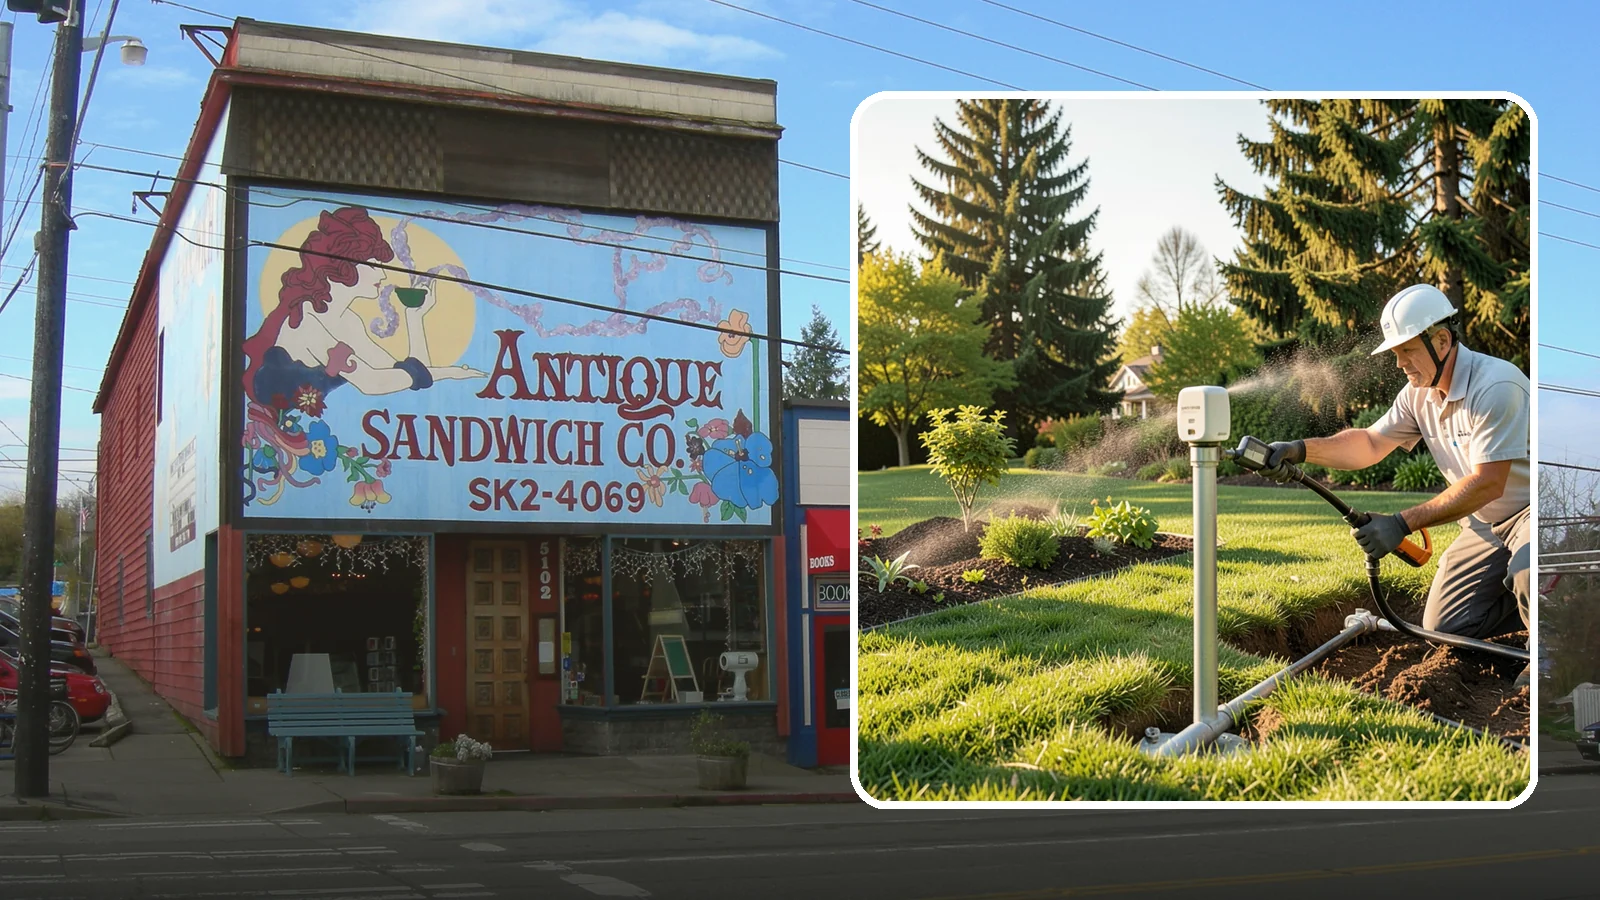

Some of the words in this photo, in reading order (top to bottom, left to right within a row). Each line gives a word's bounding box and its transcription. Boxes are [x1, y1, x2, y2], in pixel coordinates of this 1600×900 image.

[476, 329, 724, 420] ANTIQUE
[361, 408, 604, 467] SANDWICH
[617, 420, 685, 469] CO.
[468, 478, 646, 513] SK2-4069
[540, 542, 552, 600] 5102
[809, 555, 835, 569] BOOKS
